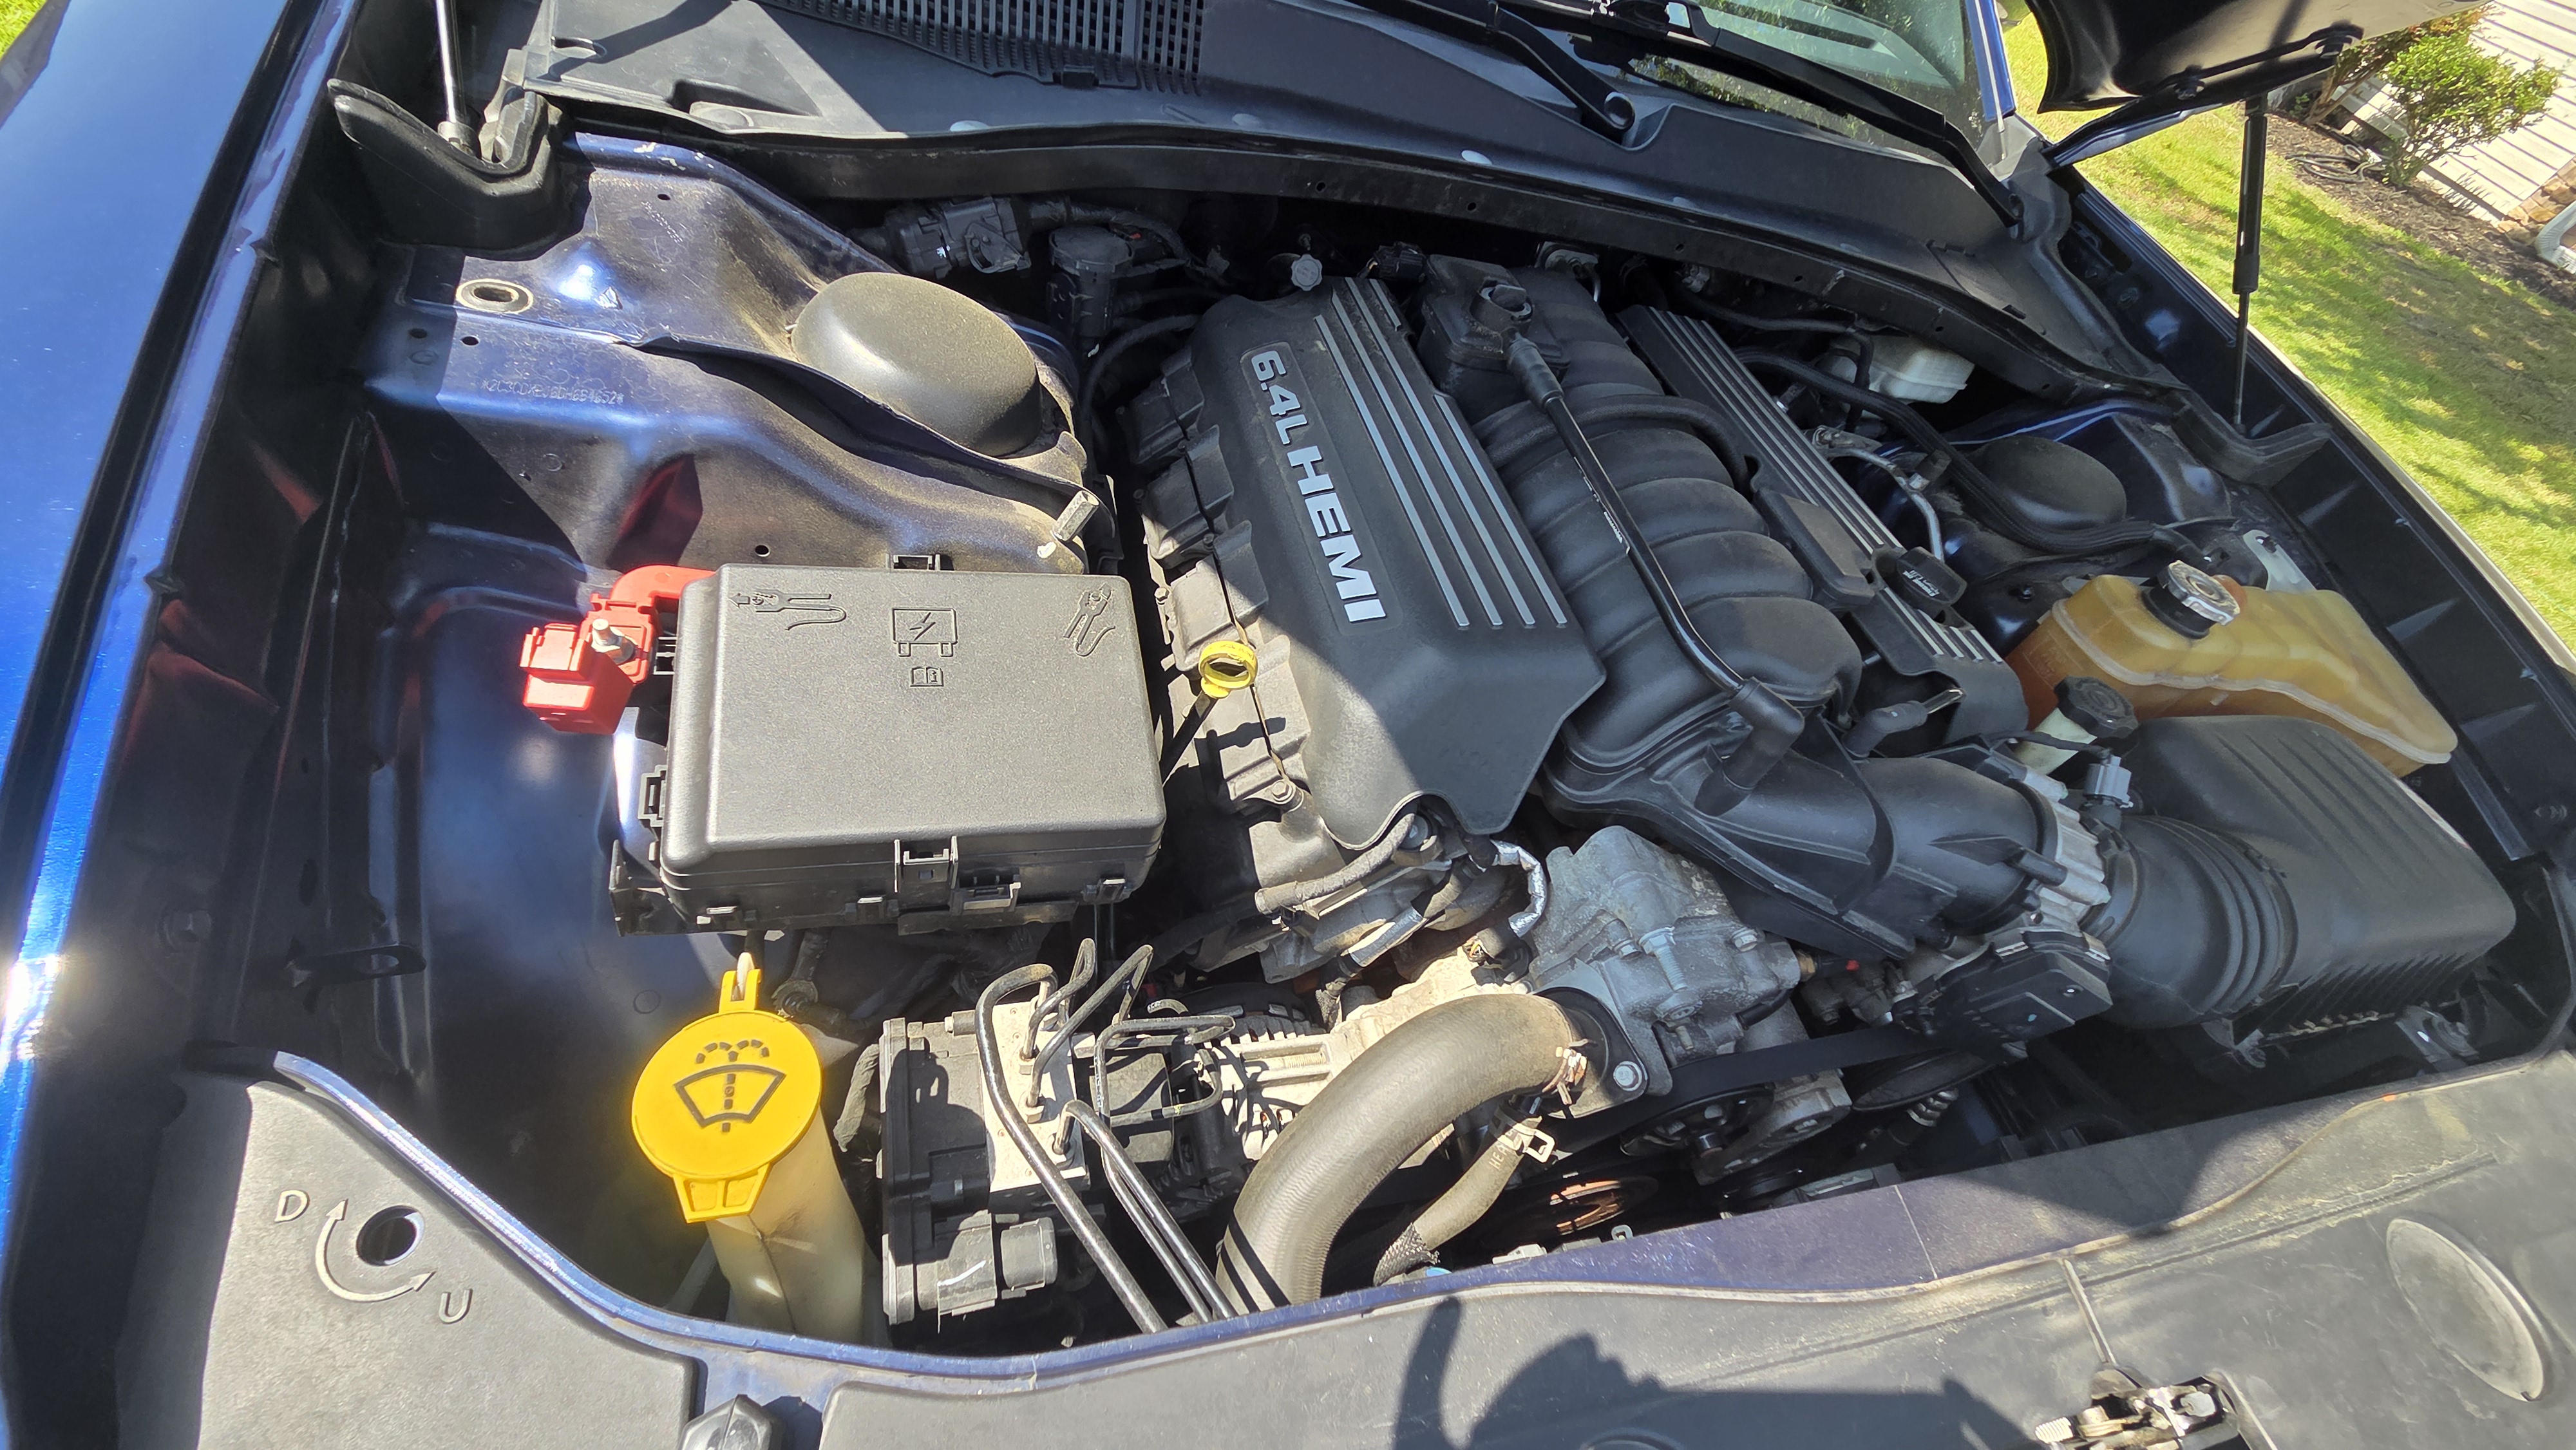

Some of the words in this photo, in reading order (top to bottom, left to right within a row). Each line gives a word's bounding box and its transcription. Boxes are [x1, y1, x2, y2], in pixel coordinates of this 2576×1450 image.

[1251, 350, 1307, 444] 6.4L
[1287, 446, 1386, 622] HEMI
[275, 1190, 310, 1222] D
[439, 1288, 473, 1324] U
